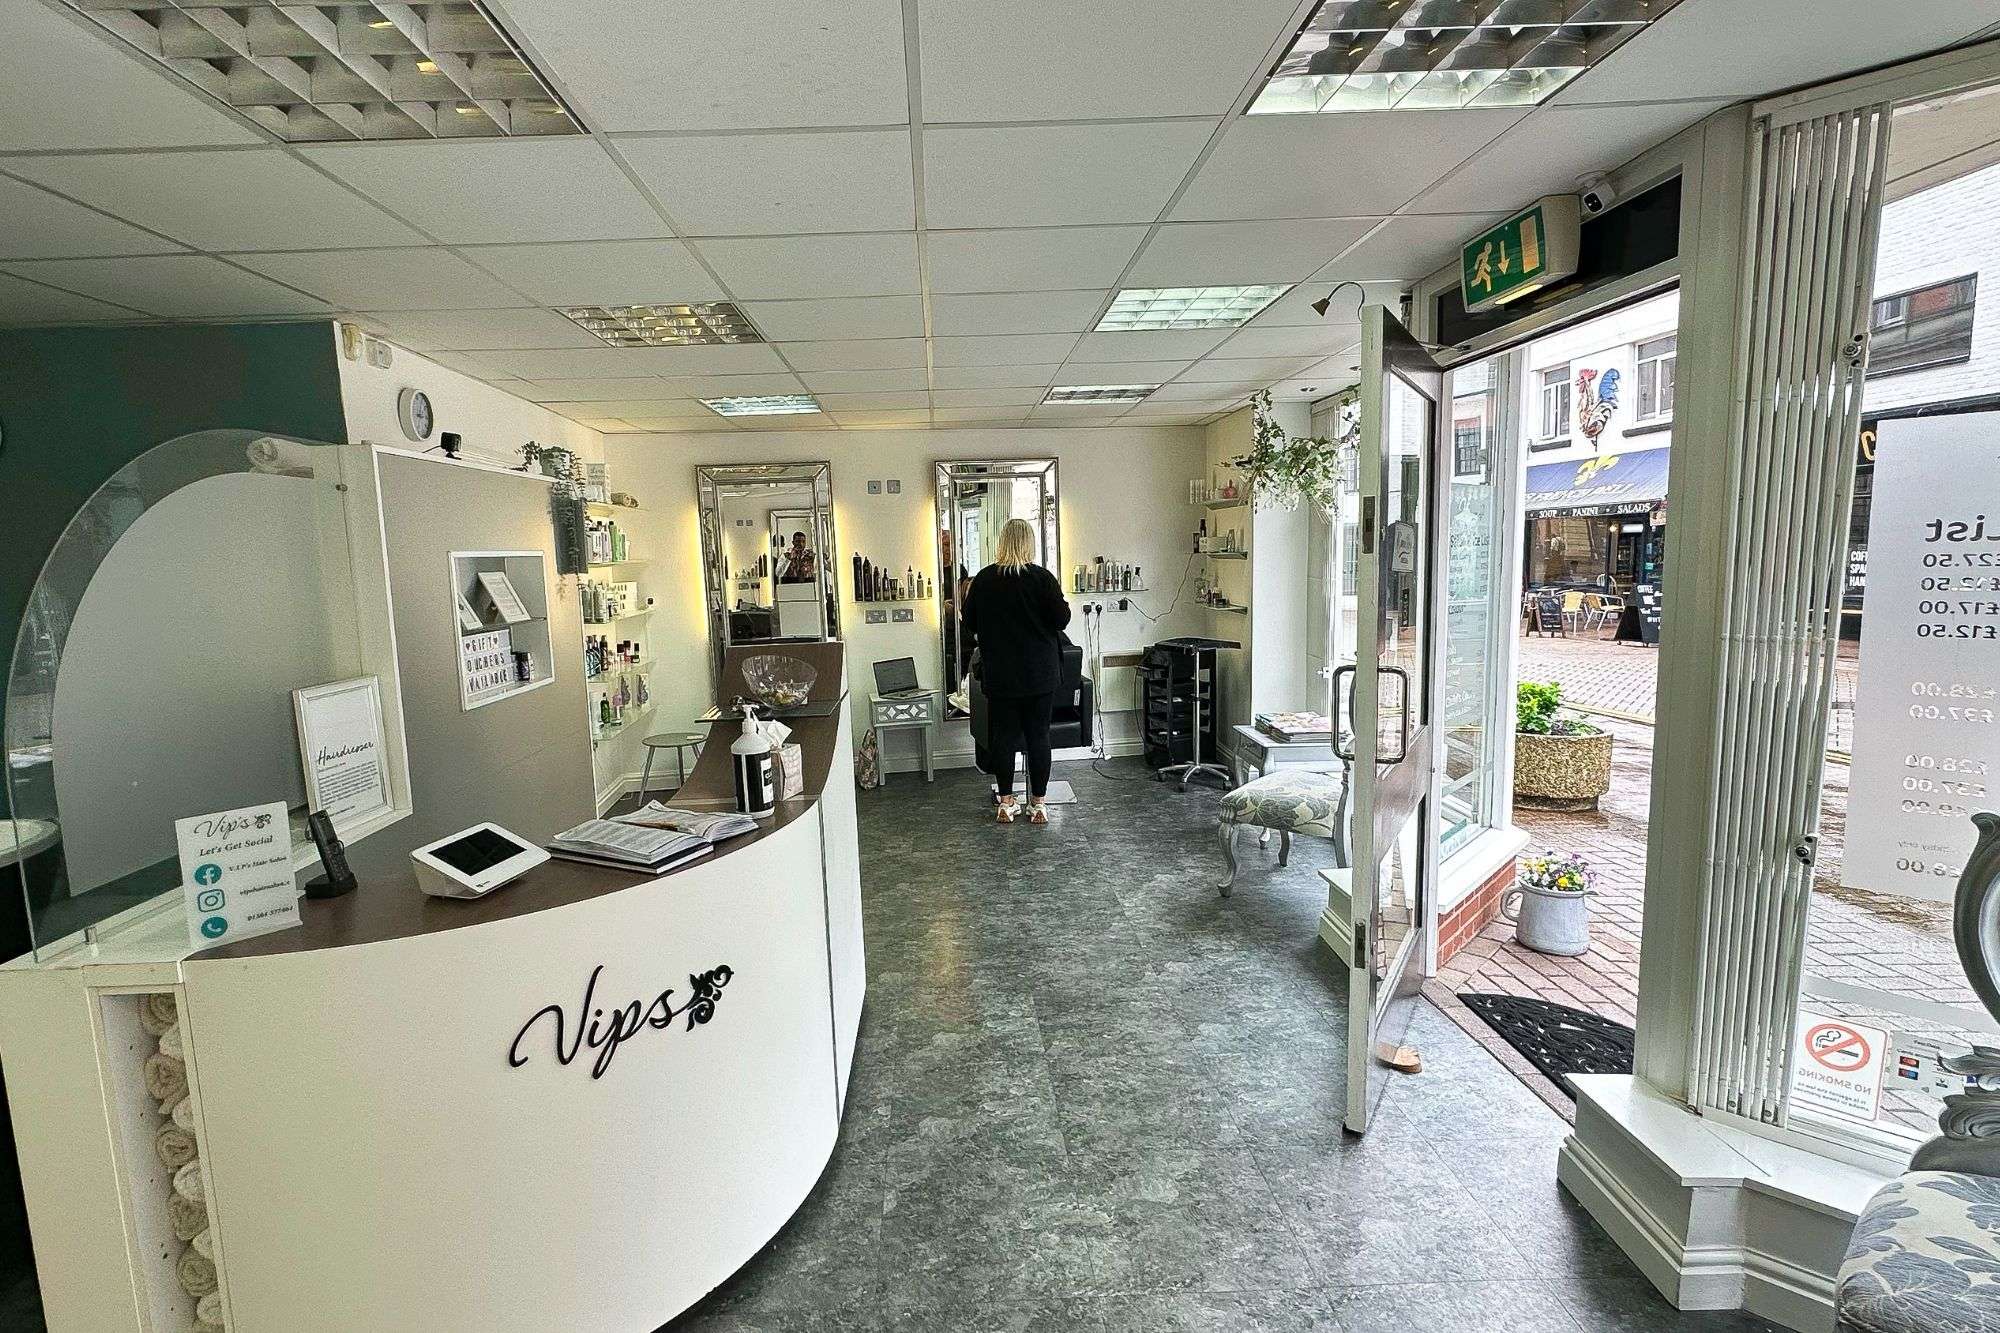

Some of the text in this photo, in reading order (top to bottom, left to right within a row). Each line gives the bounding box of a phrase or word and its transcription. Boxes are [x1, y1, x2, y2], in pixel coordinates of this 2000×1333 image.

[1538, 502, 1651, 518] SOUP PANINI SALADS
[472, 637, 492, 652] GIFT
[467, 653, 505, 672] OUCHERS
[468, 669, 508, 692] VAILABLE
[193, 814, 250, 840] Vip's
[200, 835, 273, 856] Let's Get Social
[508, 965, 676, 1080] Vips
